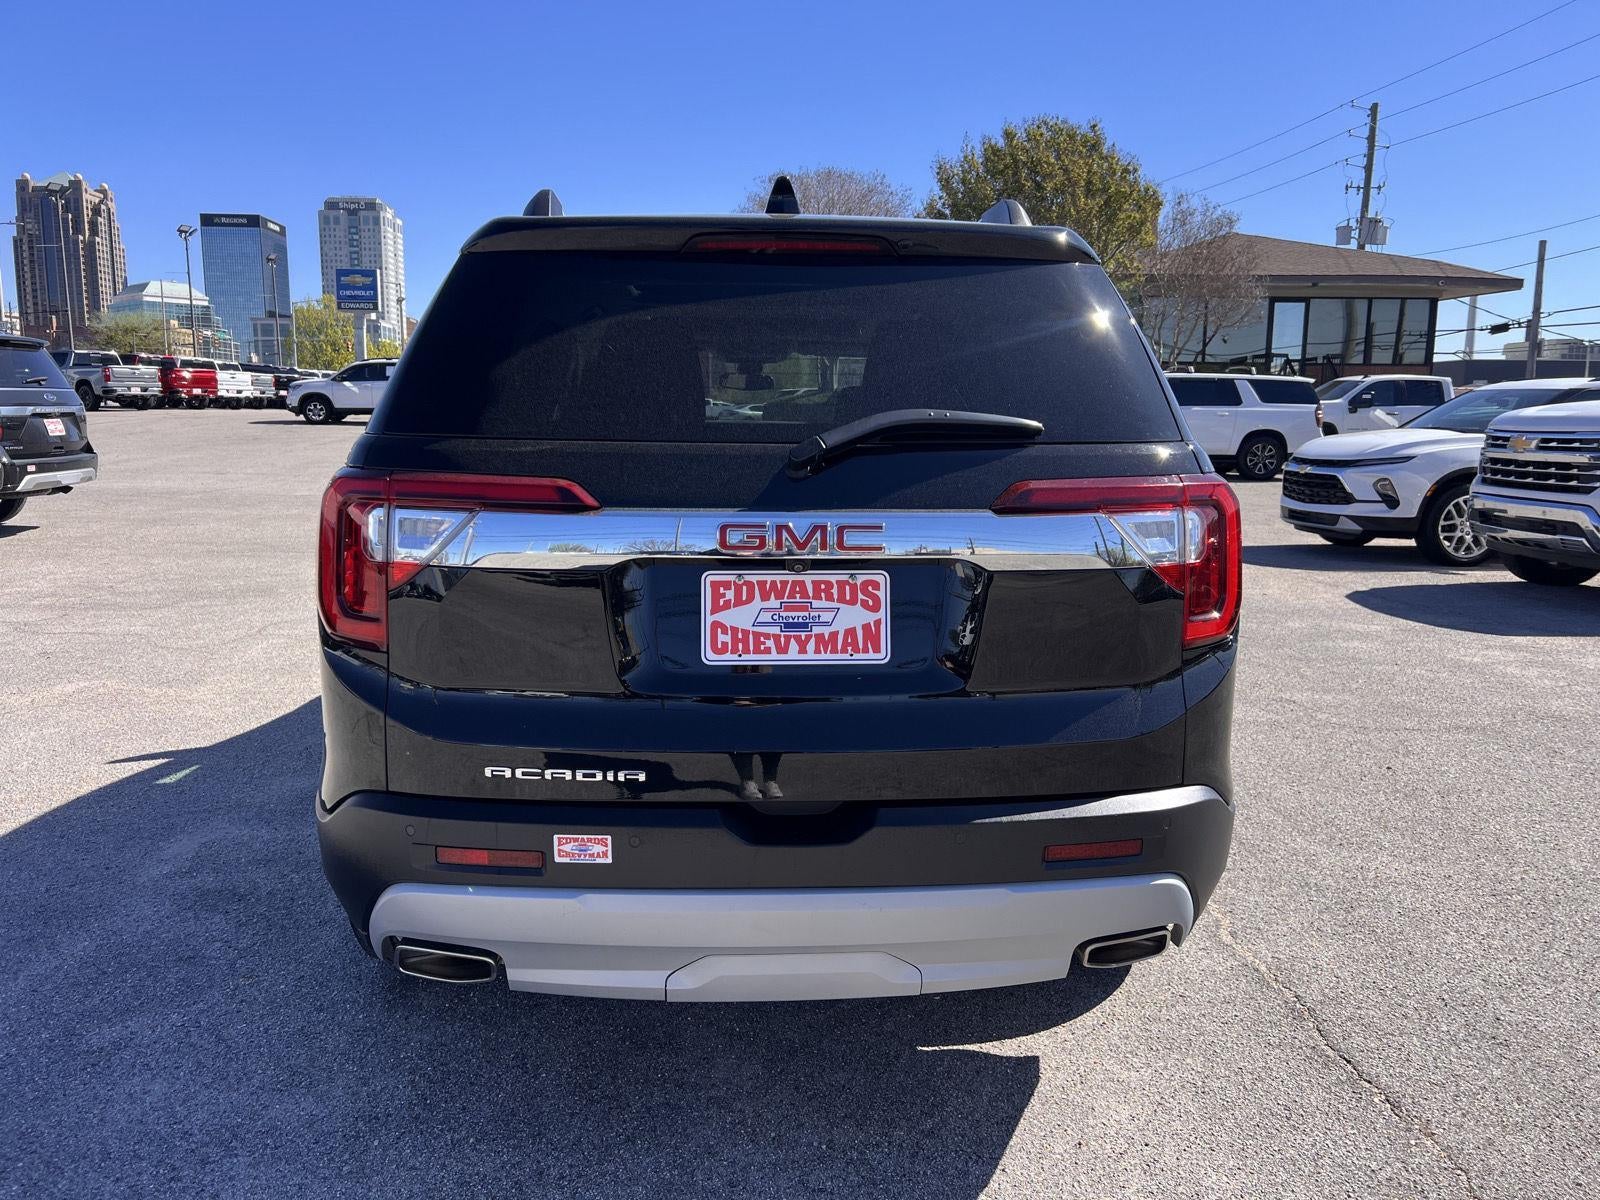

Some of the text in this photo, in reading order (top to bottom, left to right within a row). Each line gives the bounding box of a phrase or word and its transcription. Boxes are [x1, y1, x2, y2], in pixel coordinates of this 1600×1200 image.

[338, 202, 360, 210] Shipt
[716, 522, 886, 554] GMC
[709, 579, 882, 616] EDWARDS
[771, 612, 822, 622] Chevrolet
[710, 618, 882, 655] CHEVYMAN
[484, 766, 646, 782] ACADIA
[557, 837, 609, 848] EDWARDS
[558, 848, 609, 859] CHEVYMAN
